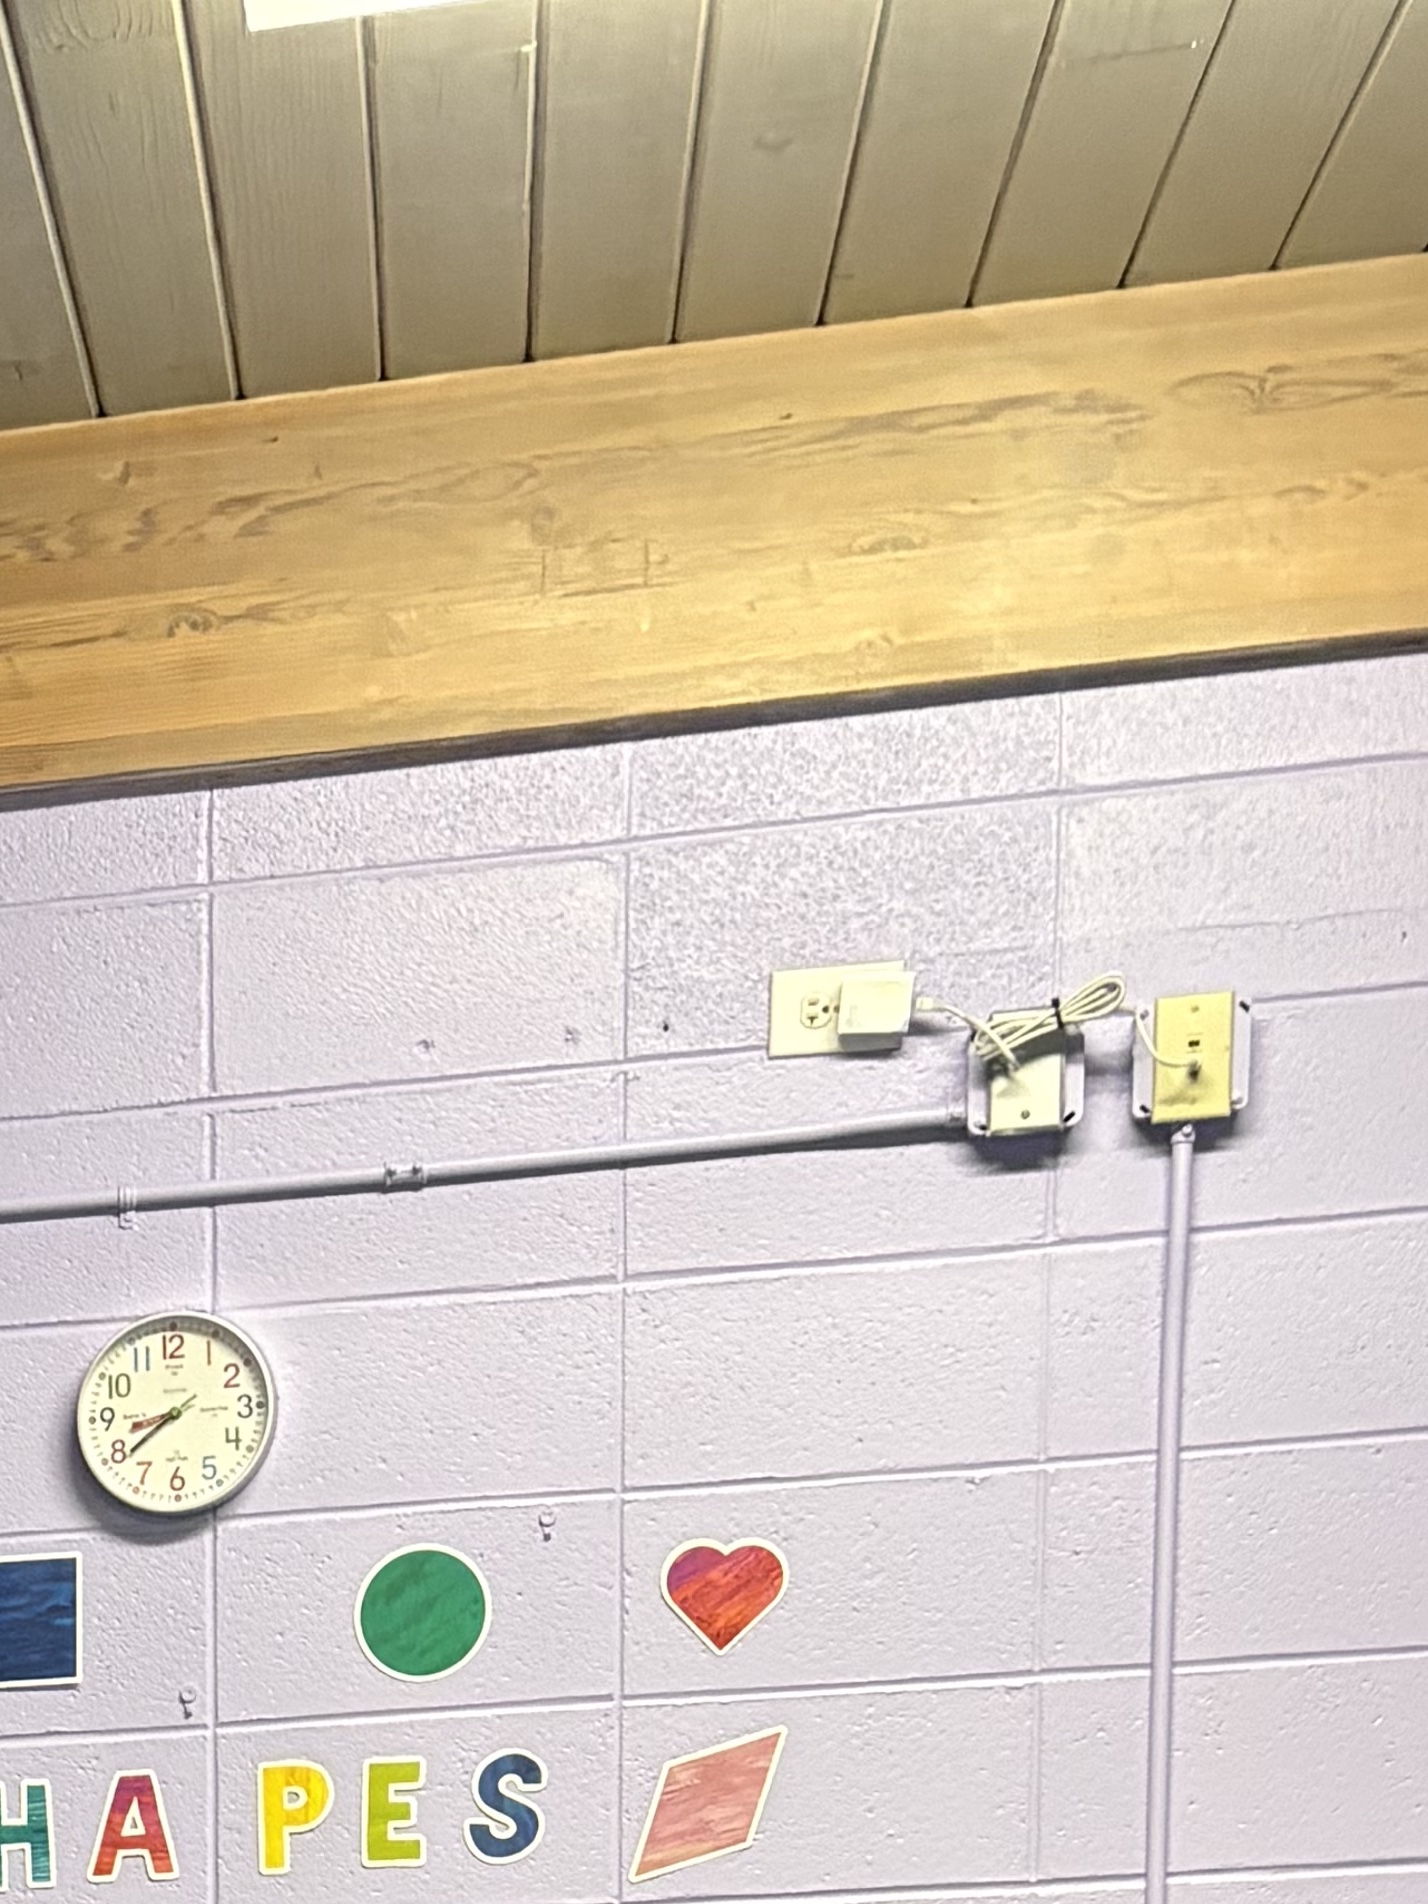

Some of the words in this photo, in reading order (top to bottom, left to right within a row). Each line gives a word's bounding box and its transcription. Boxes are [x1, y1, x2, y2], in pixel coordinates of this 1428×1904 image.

[133, 1345, 151, 1373] 11
[162, 1333, 185, 1360] 12
[107, 1373, 132, 1400] 10
[223, 1363, 241, 1388] 2
[236, 1394, 254, 1419] 3
[99, 1407, 116, 1432] 9
[224, 1426, 242, 1451] 4
[110, 1439, 127, 1464] 8
[136, 1461, 153, 1486] 7
[169, 1466, 186, 1491] 6
[201, 1455, 218, 1480] 5
